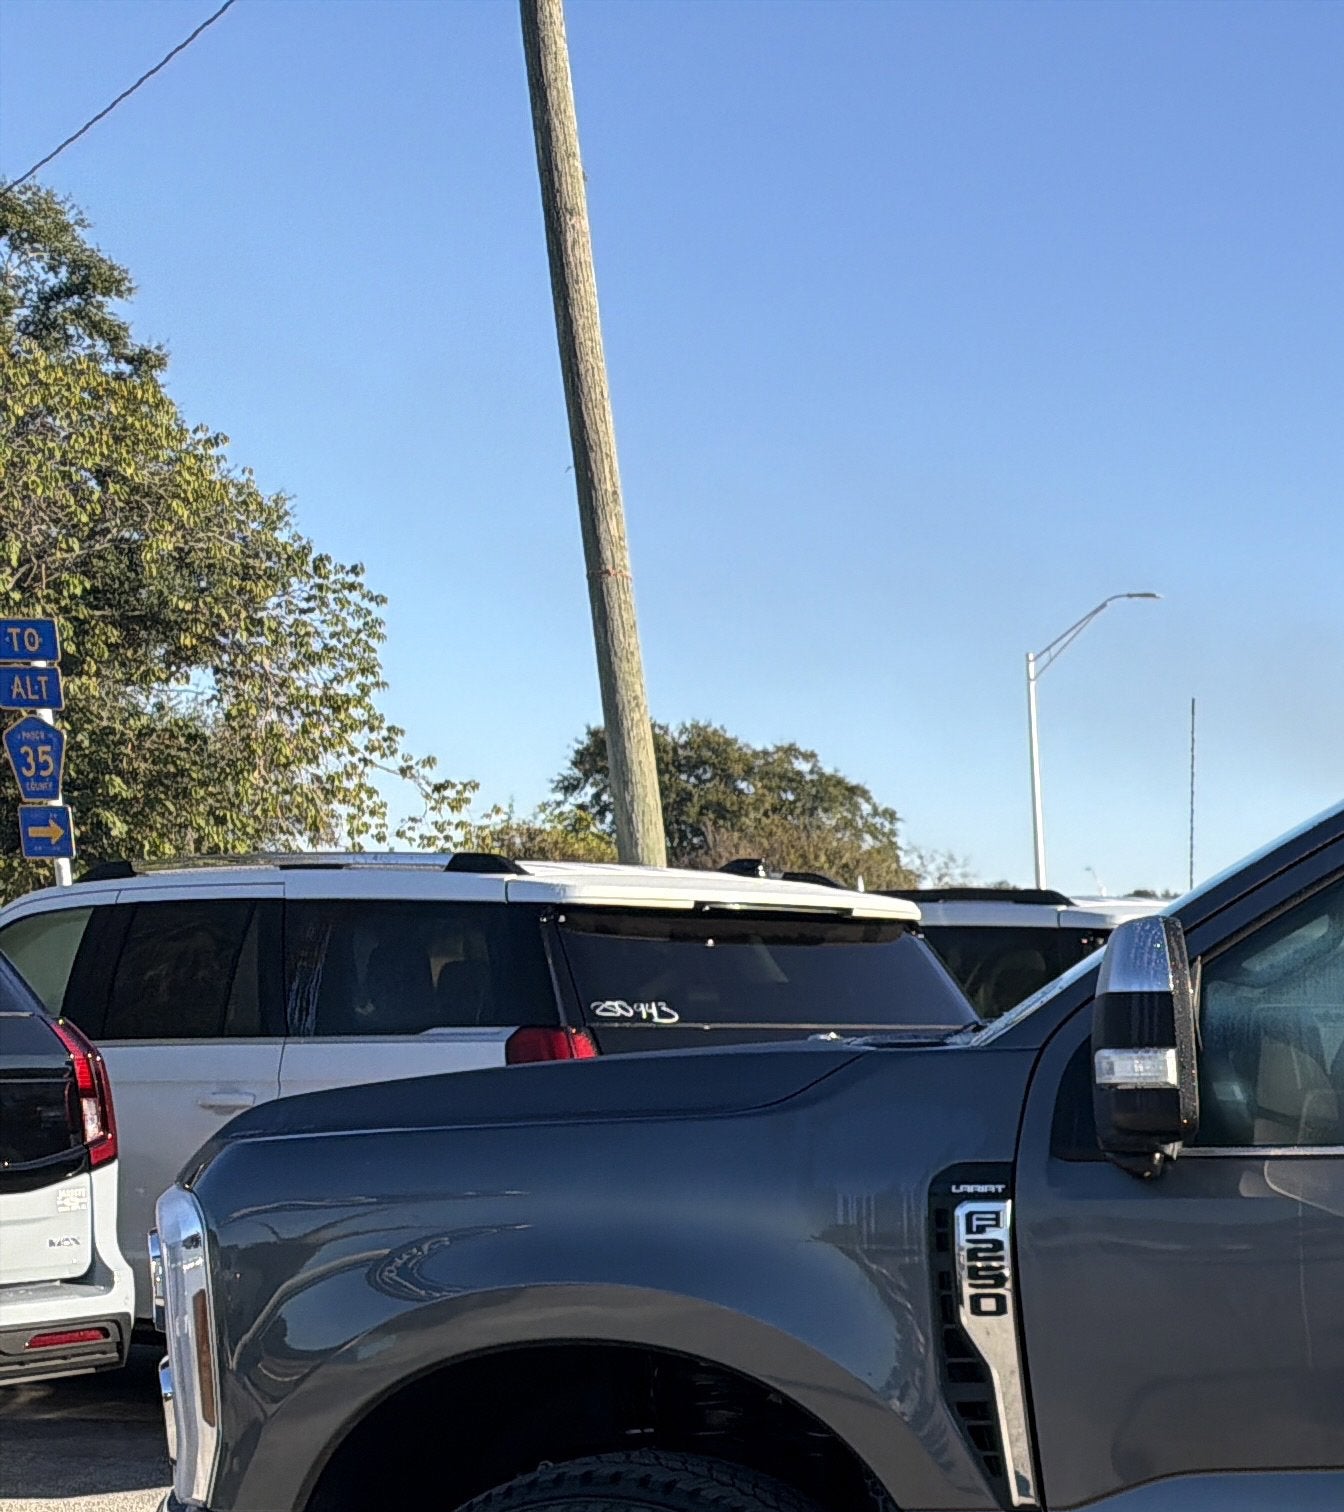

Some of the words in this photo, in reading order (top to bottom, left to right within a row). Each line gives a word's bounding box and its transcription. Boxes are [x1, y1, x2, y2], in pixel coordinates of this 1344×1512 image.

[7, 627, 39, 652] TO
[12, 675, 48, 700] ALT
[20, 745, 54, 777] 35
[951, 1184, 1006, 1193] LARIAT
